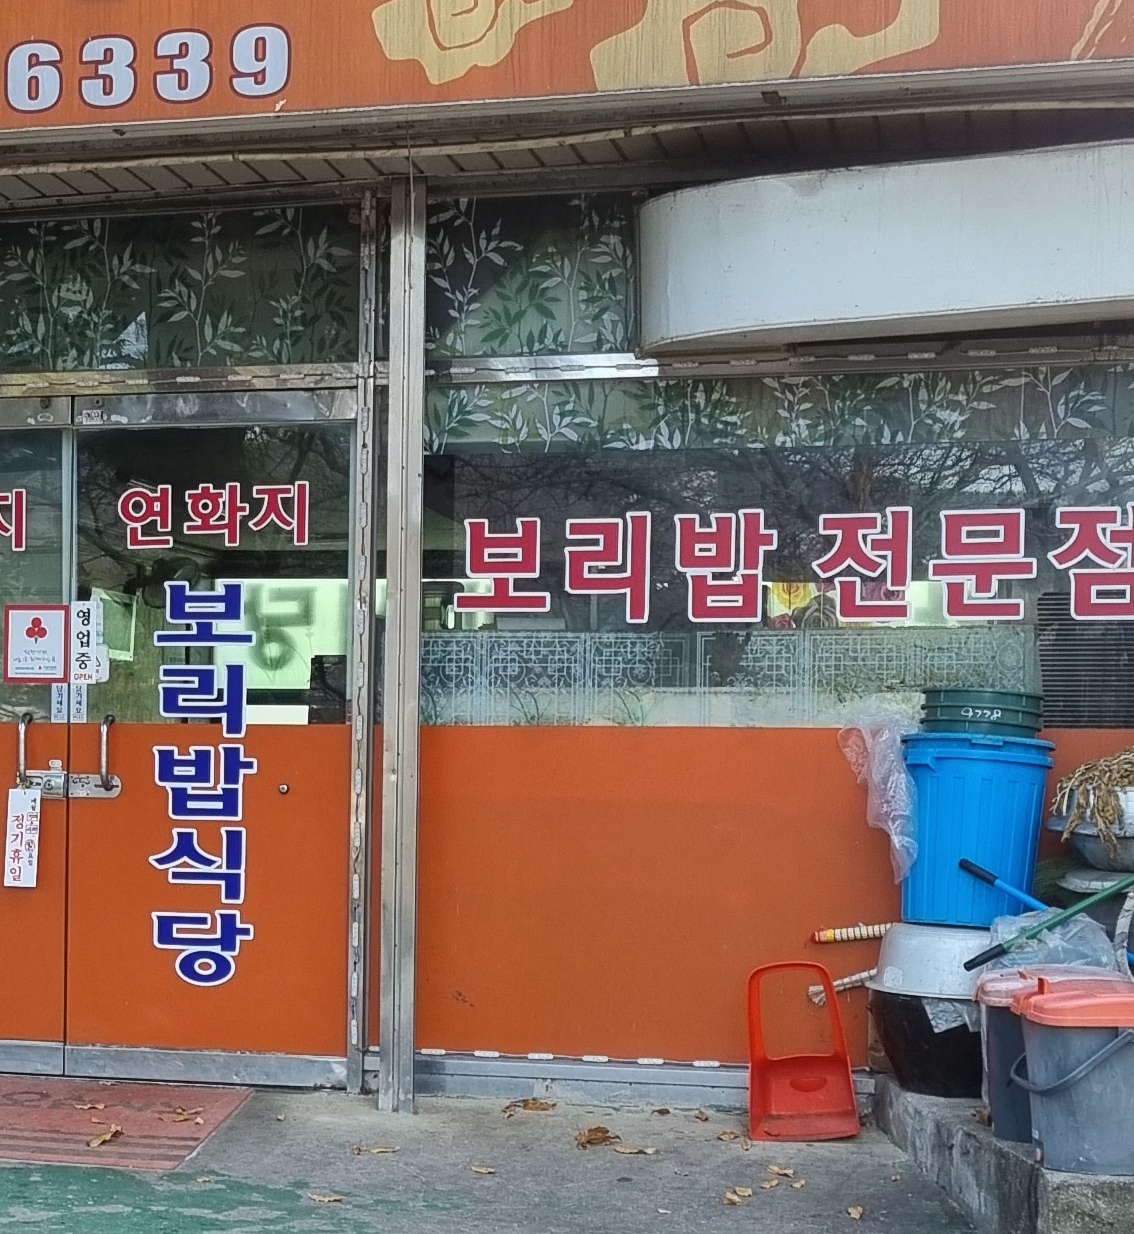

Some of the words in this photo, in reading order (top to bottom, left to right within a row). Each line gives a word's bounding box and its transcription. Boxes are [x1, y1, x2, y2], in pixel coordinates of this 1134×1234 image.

[118, 480, 309, 551] 연화지
[74, 607, 92, 670] 영업중
[73, 673, 93, 681] OPEN
[9, 813, 25, 882] 정기휴일
